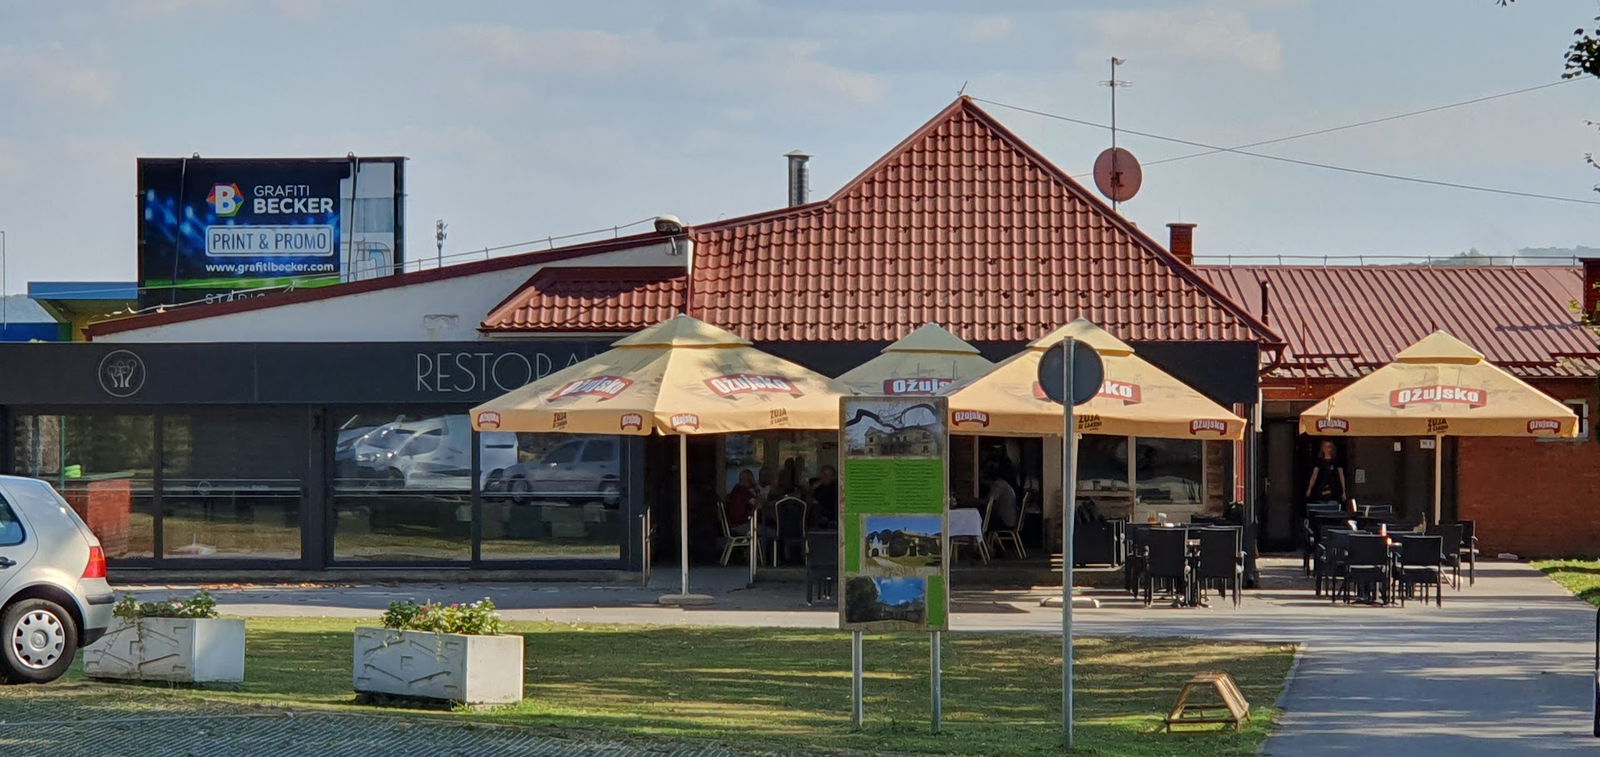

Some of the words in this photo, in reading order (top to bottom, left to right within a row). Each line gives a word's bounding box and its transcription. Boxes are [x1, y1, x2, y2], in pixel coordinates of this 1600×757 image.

[253, 185, 310, 197] GRAFITI
[253, 198, 334, 214] BECKER
[212, 233, 253, 250] PRINT
[258, 233, 270, 250] &
[274, 232, 326, 250] PROMO
[205, 262, 334, 274] www.grafitibecker.com
[1397, 386, 1480, 403] Ožujsko
